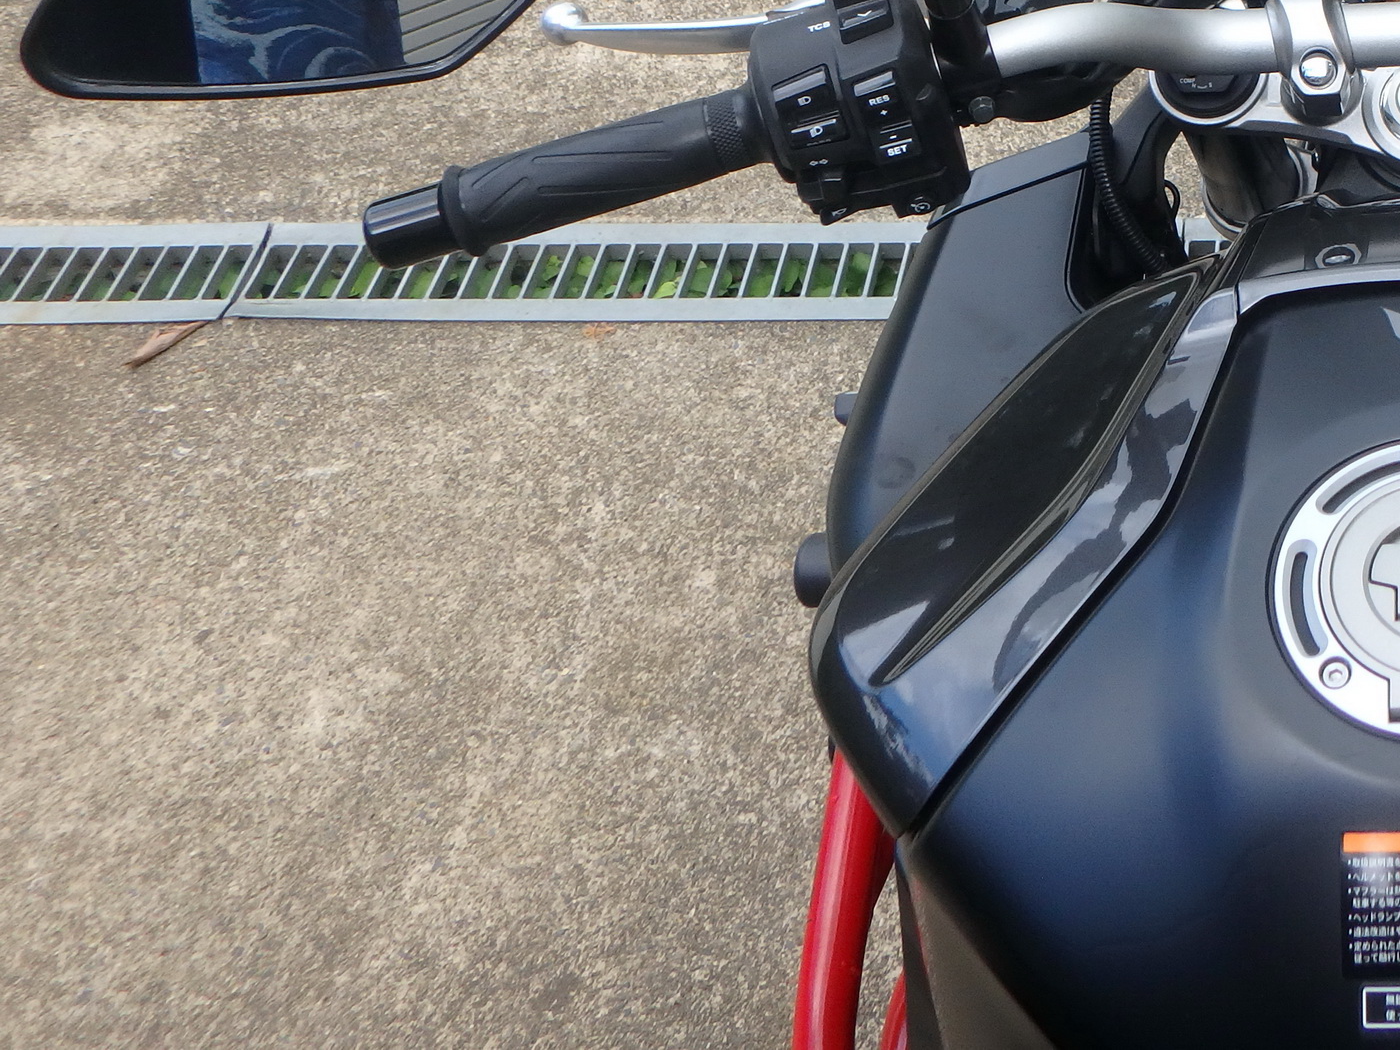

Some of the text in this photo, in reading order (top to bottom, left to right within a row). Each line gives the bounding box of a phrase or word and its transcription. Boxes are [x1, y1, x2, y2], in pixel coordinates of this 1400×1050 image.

[808, 21, 831, 32] TCS
[869, 94, 890, 106] RES
[887, 145, 908, 157] SET
